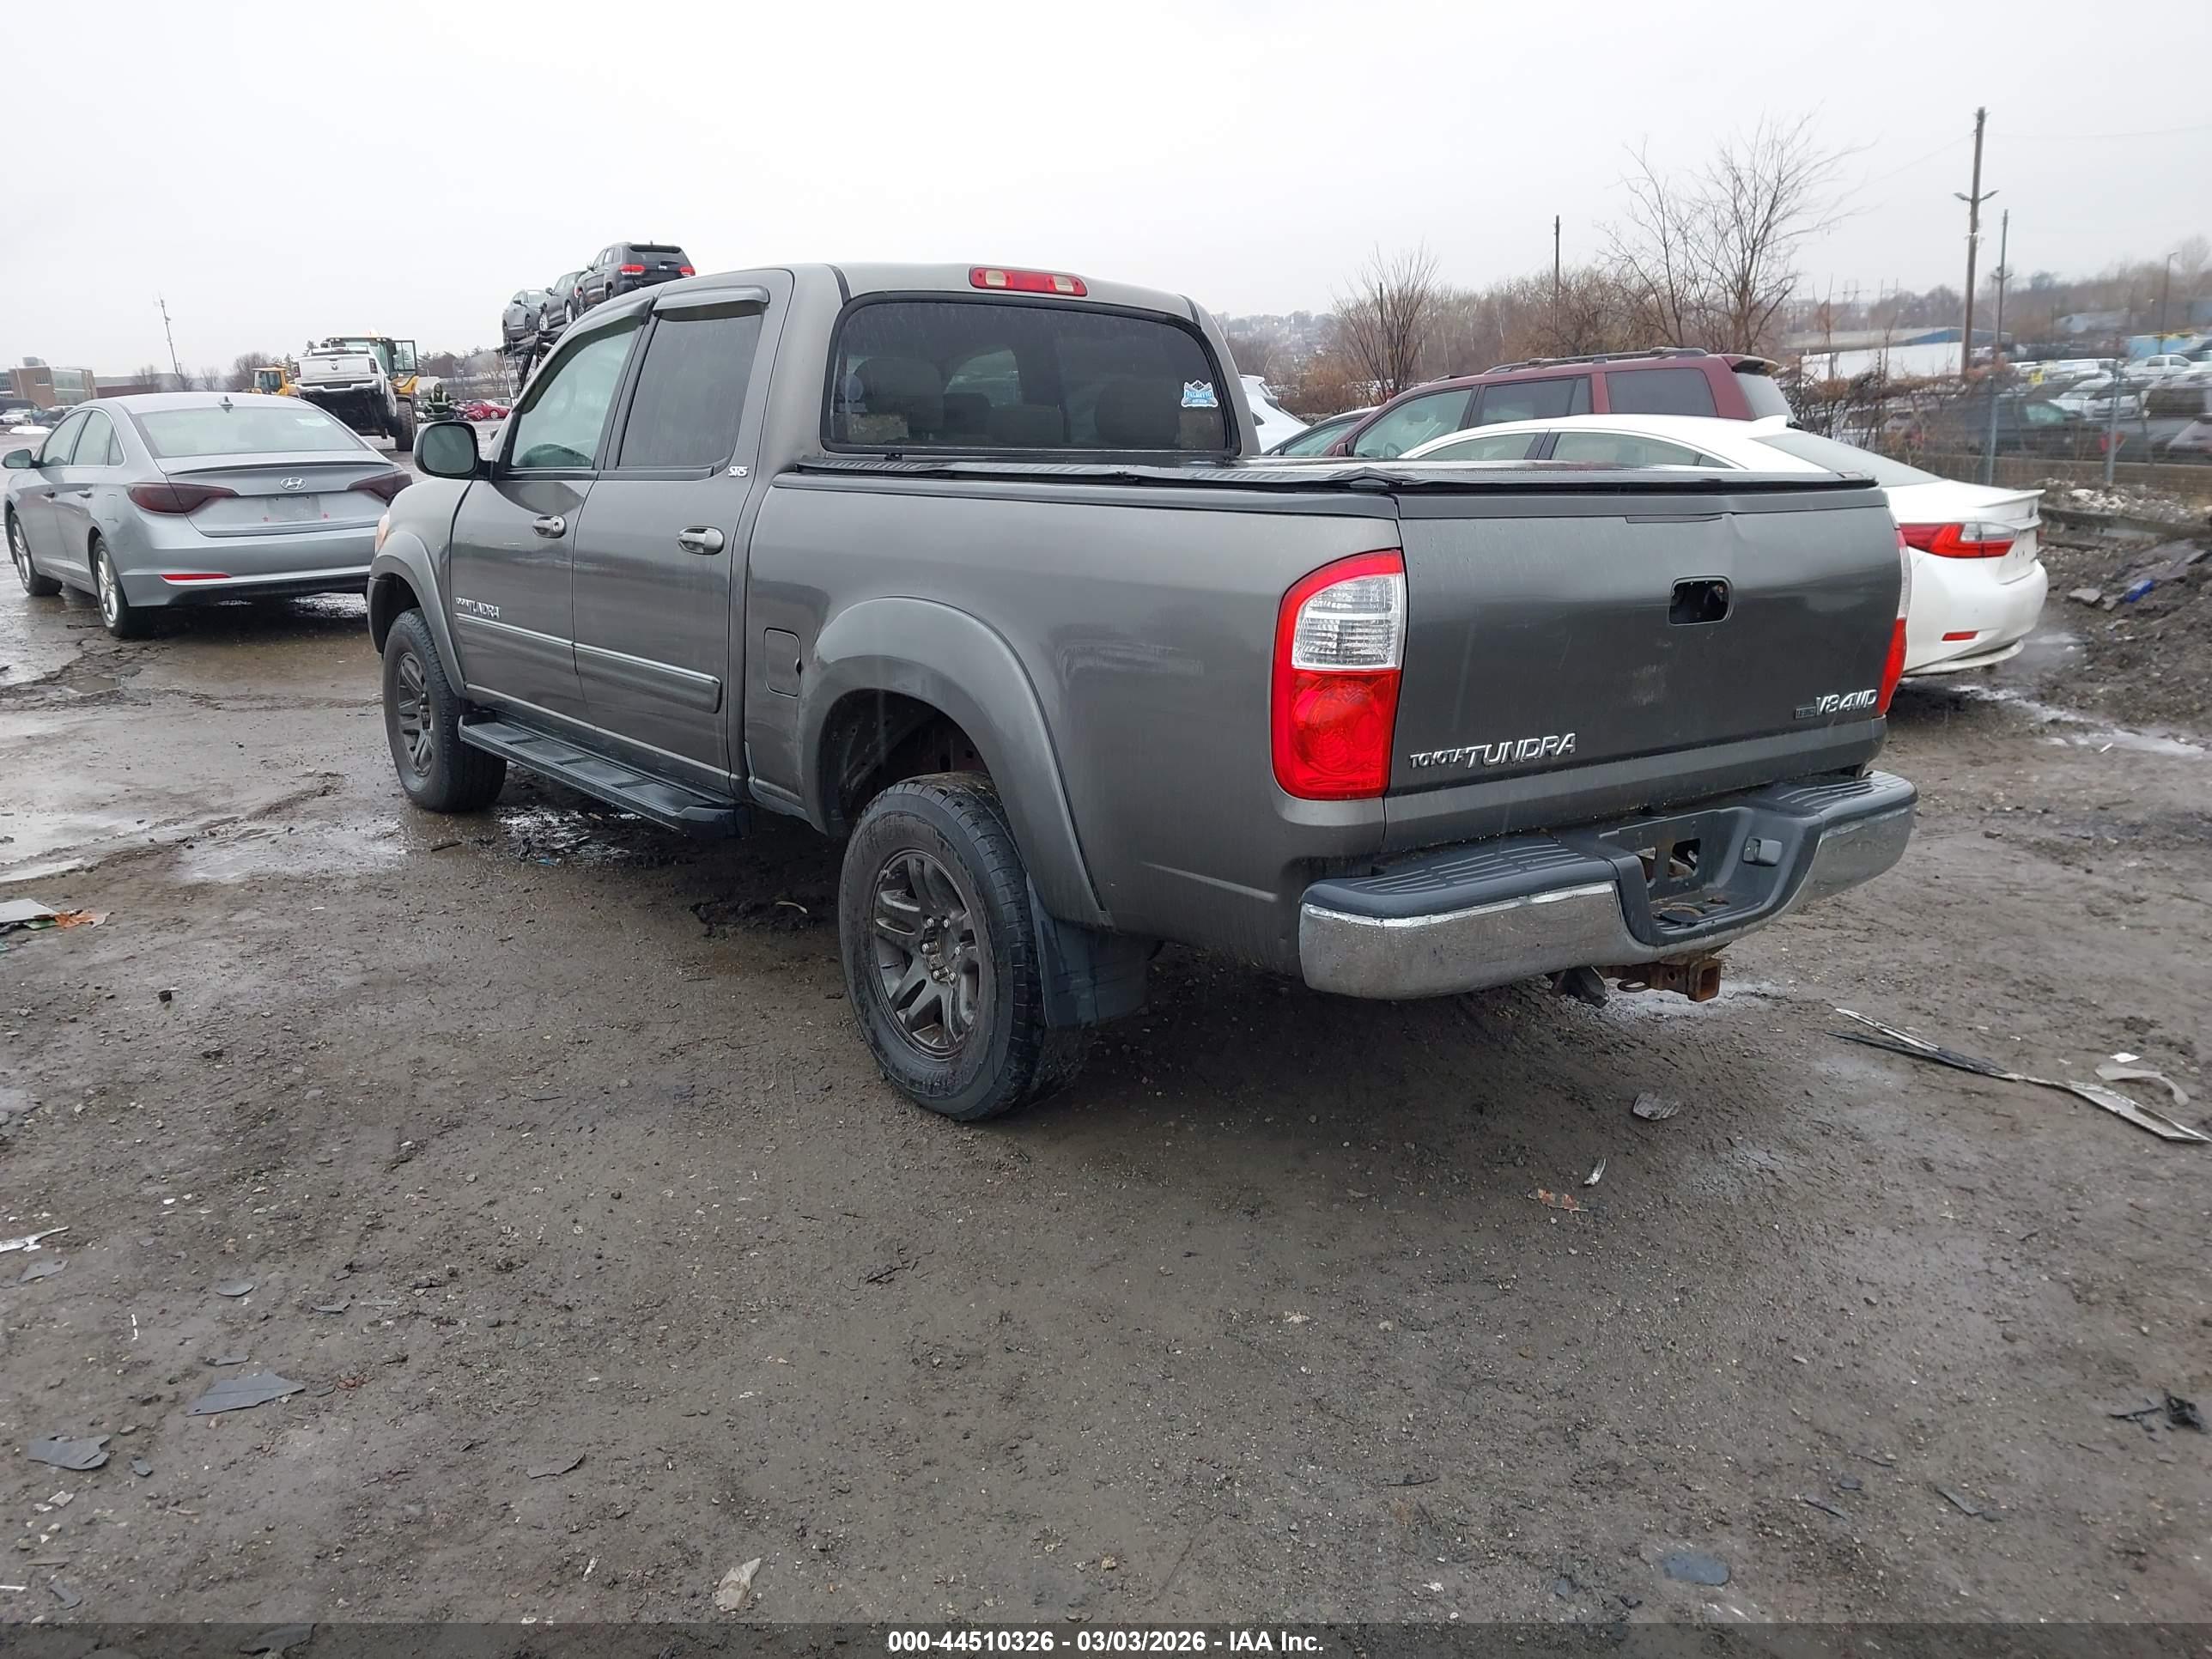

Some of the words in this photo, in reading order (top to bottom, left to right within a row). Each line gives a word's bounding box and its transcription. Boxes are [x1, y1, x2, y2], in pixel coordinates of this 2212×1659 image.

[467, 599, 501, 619] TUNDRA
[1815, 694, 1840, 715] V8
[1409, 747, 1465, 769] TOYOTA
[1463, 732, 1577, 769] TUNDRA
